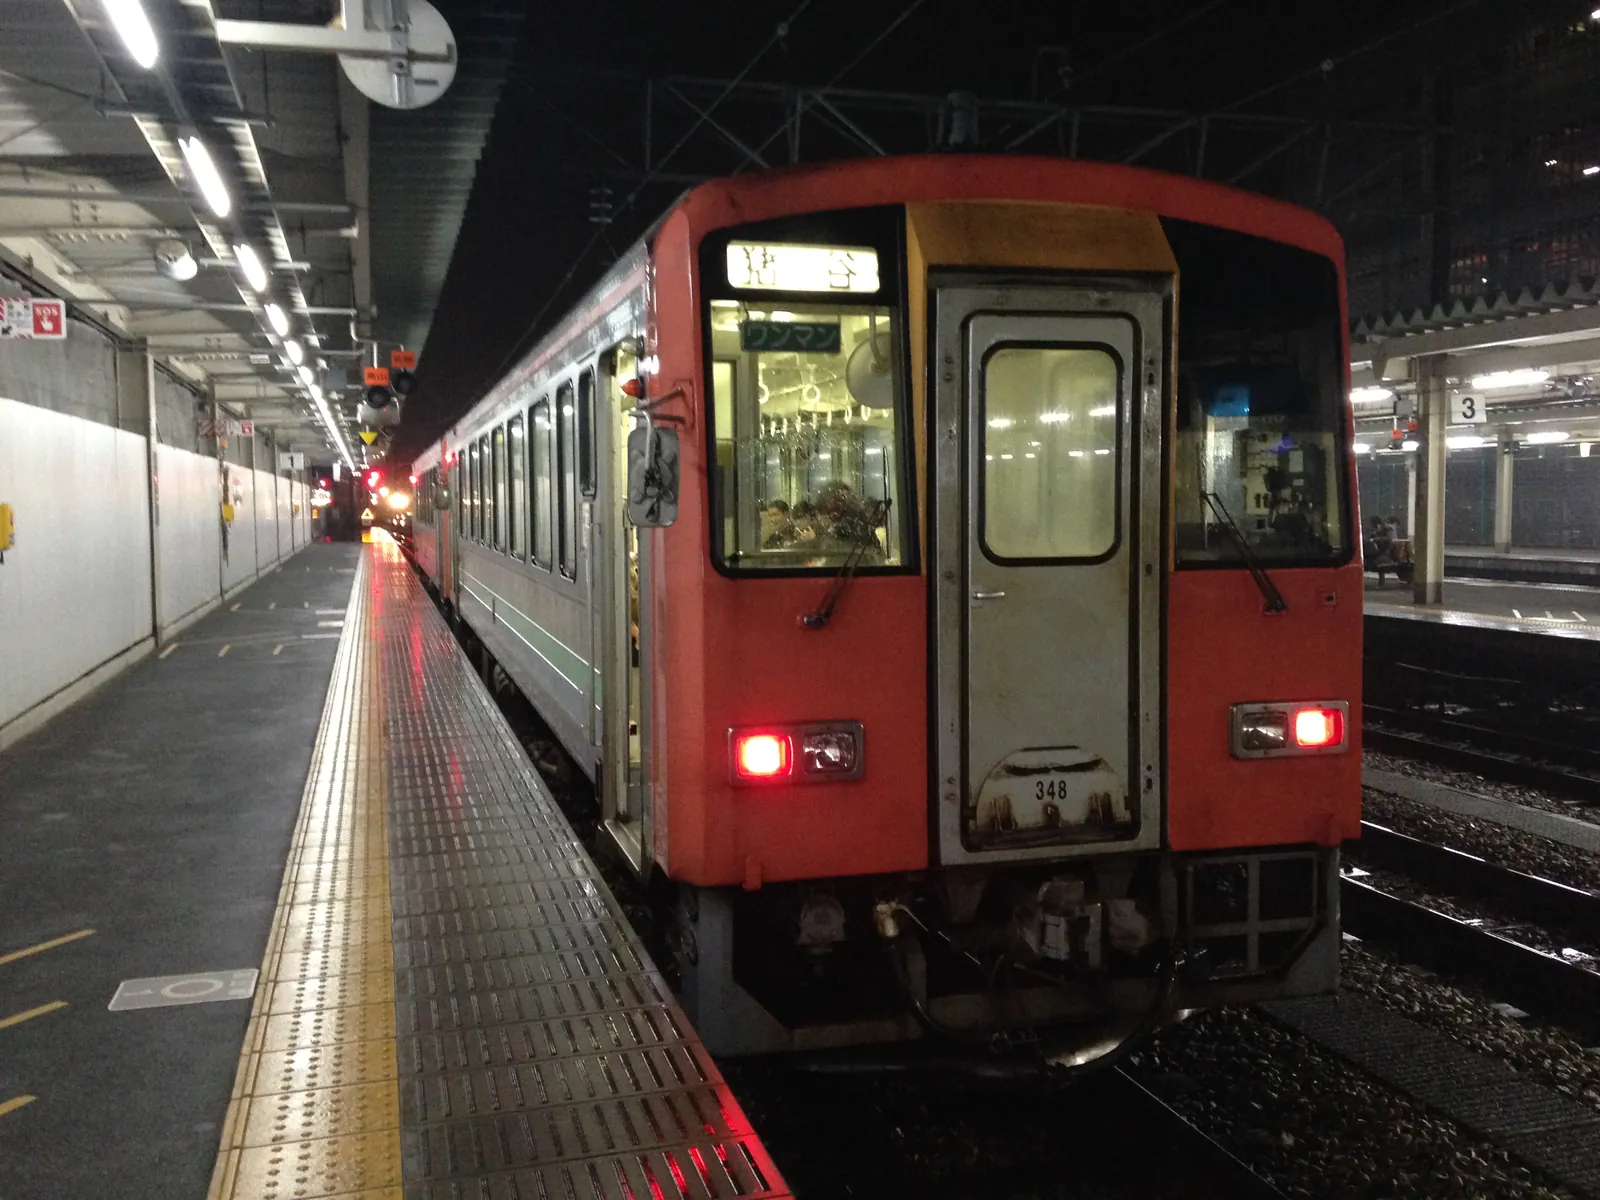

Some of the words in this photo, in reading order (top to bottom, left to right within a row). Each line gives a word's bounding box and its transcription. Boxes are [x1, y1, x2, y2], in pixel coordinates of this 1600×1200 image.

[747, 324, 837, 349] ワンマン
[1462, 397, 1476, 419] 3
[1035, 780, 1067, 800] 348
